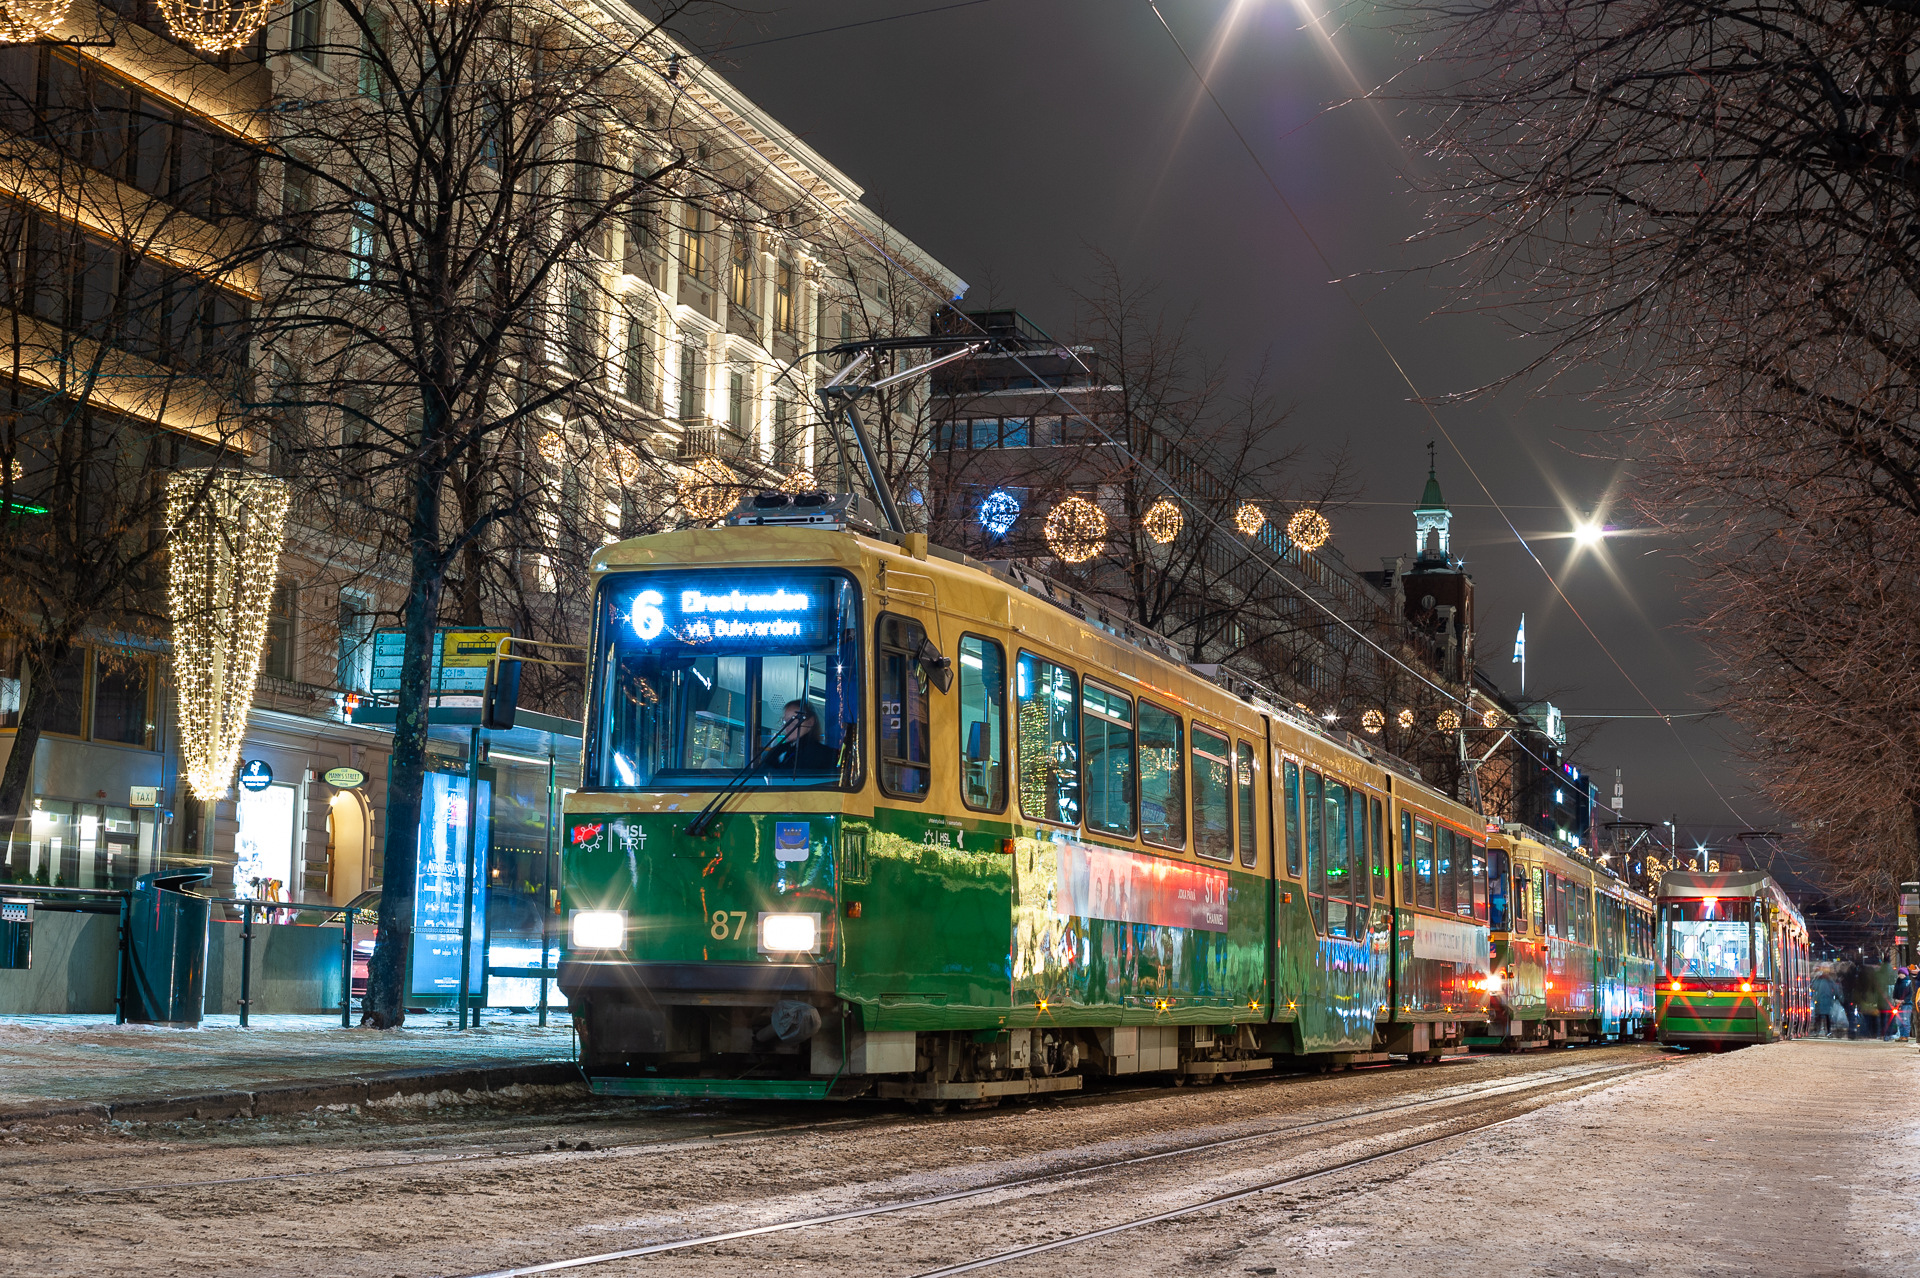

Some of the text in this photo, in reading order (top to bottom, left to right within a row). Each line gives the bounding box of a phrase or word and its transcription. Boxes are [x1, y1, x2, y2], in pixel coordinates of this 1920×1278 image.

[631, 589, 665, 641] 6
[686, 618, 801, 637] via Bulevarden
[379, 635, 385, 644] 3
[378, 646, 384, 655] 6
[376, 669, 385, 678] 10
[136, 792, 153, 801] TAXI
[619, 824, 647, 838] HSL
[940, 832, 950, 842] HSL
[619, 838, 647, 850] HRT
[1703, 902, 1715, 920] 7
[711, 910, 748, 941] 87
[1206, 912, 1224, 926] CHANNEL
